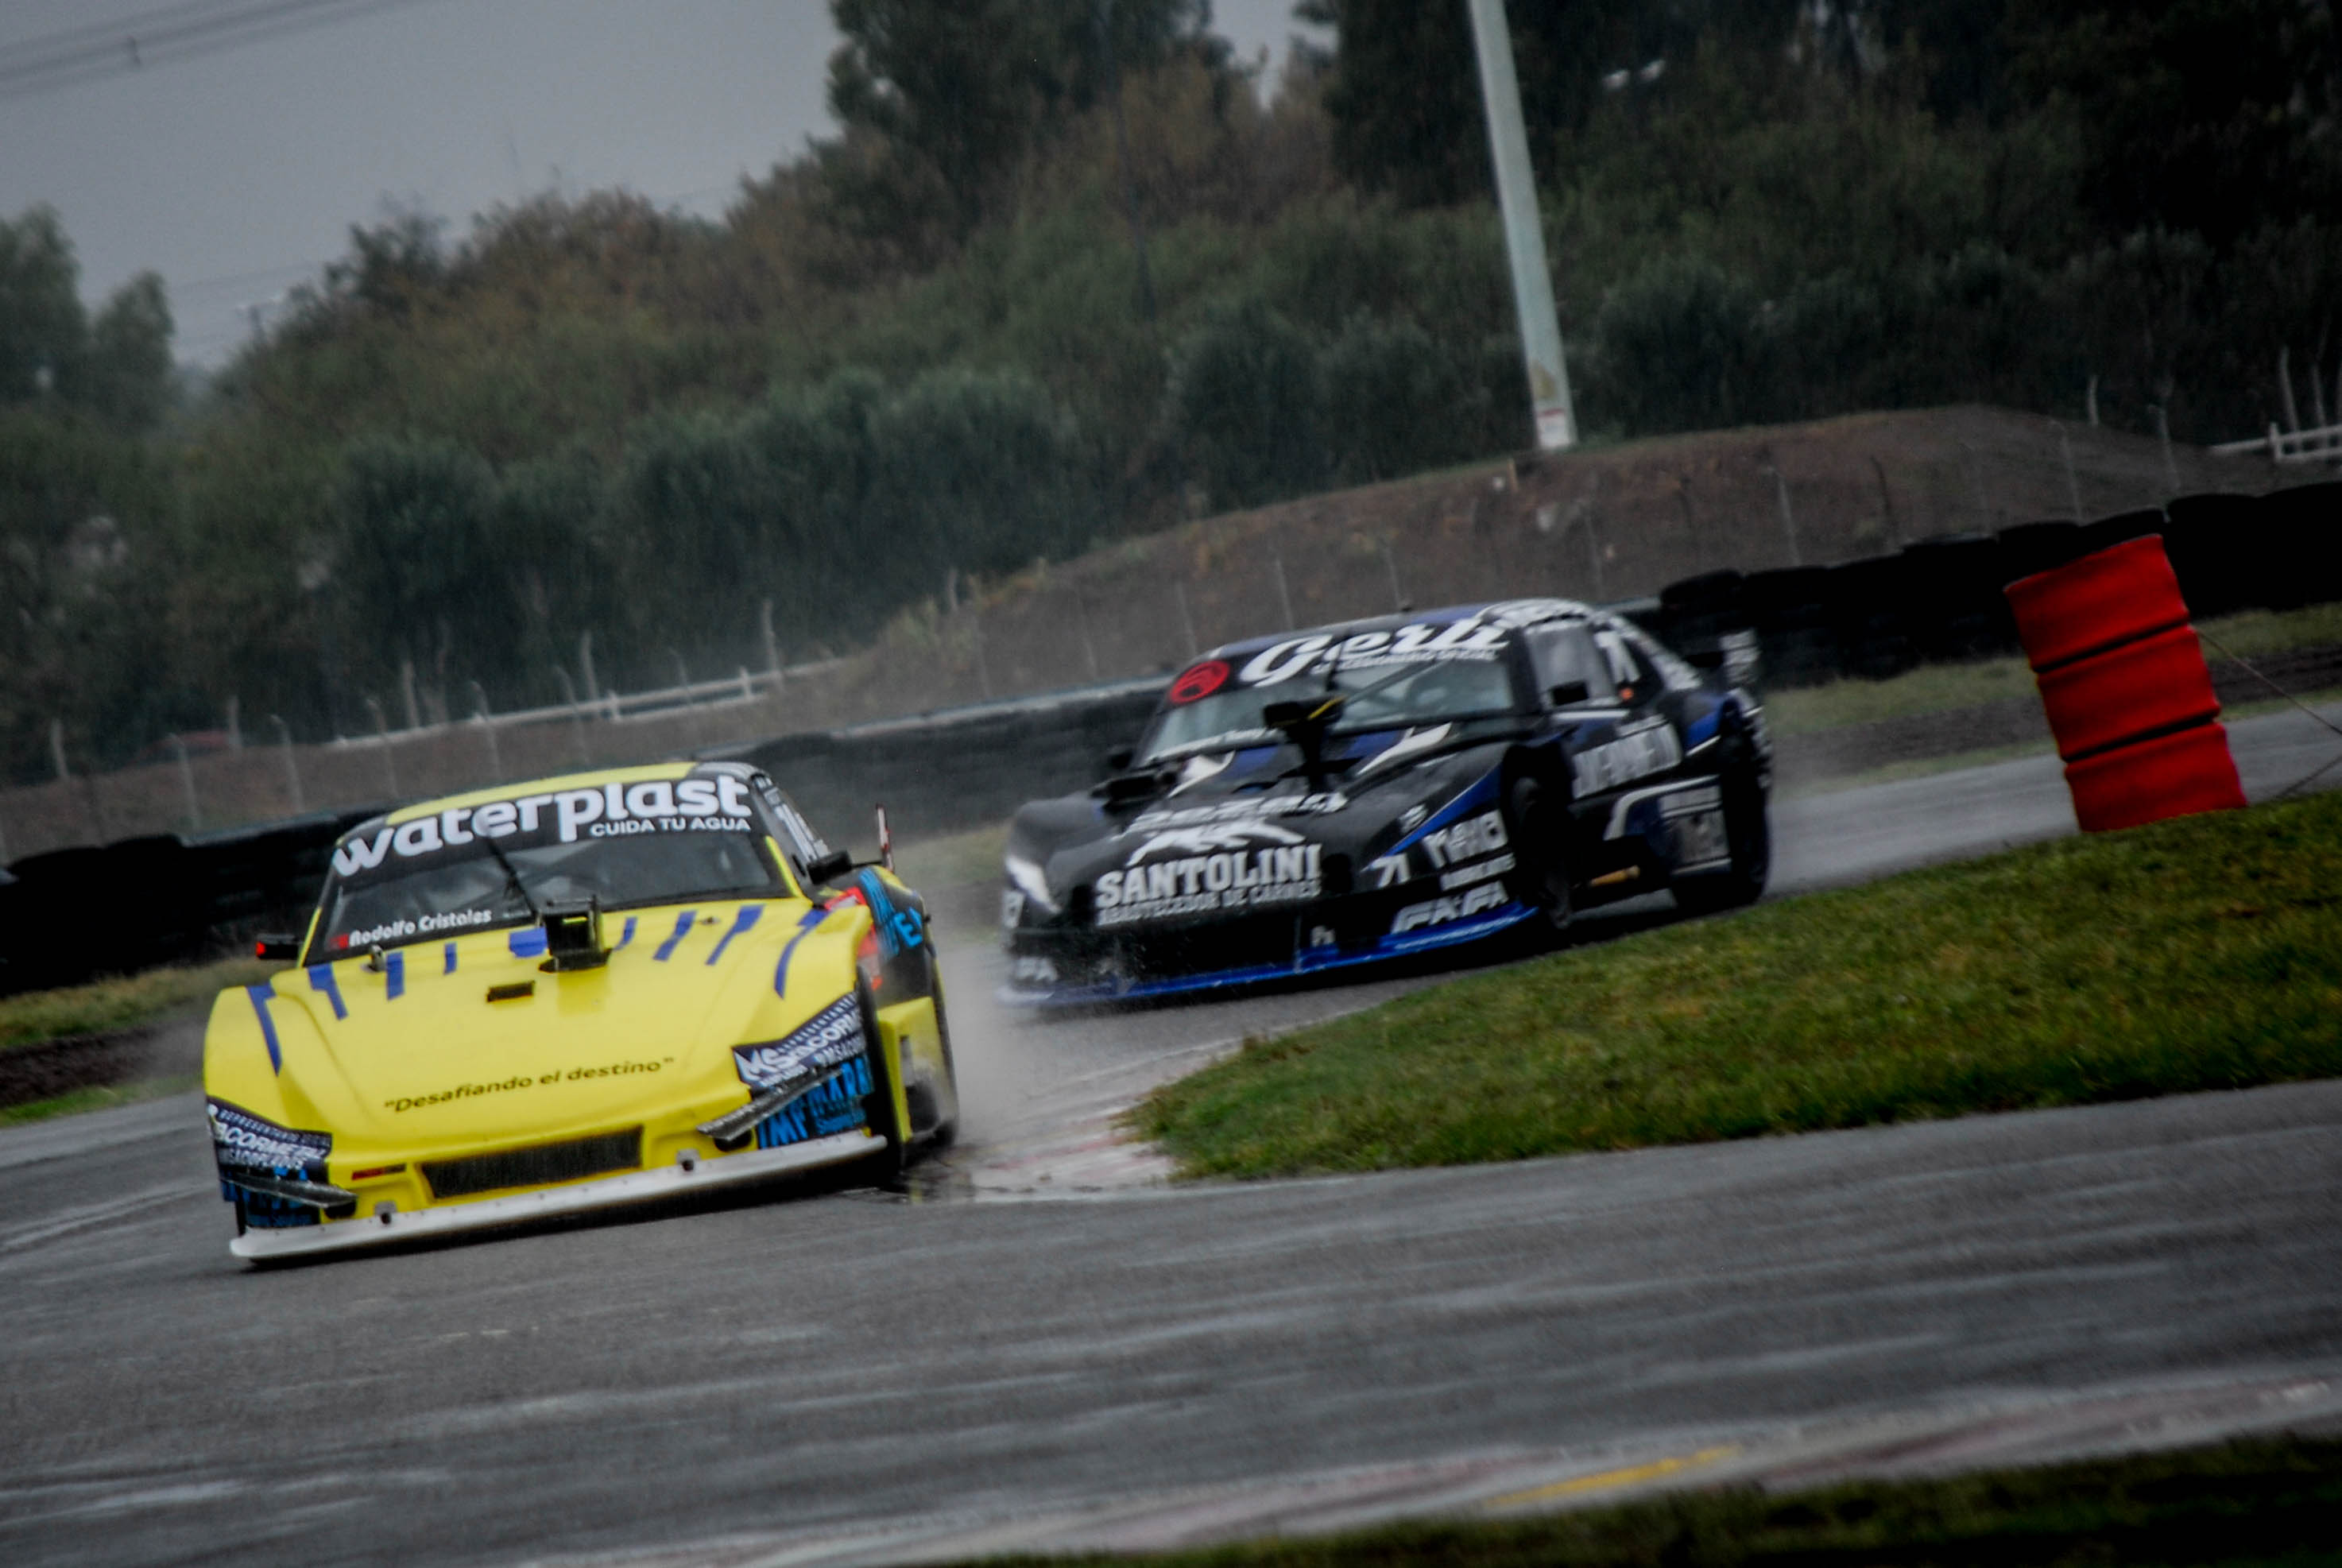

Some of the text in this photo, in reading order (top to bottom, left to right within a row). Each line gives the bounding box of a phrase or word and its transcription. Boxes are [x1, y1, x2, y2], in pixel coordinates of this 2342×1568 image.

[332, 775, 752, 877] waterplast
[590, 816, 752, 838] CUIDA TU AGUA
[1096, 842, 1323, 908] SANTOLINI
[349, 908, 493, 946] Rodolfo Cristales
[540, 1070, 560, 1085] el
